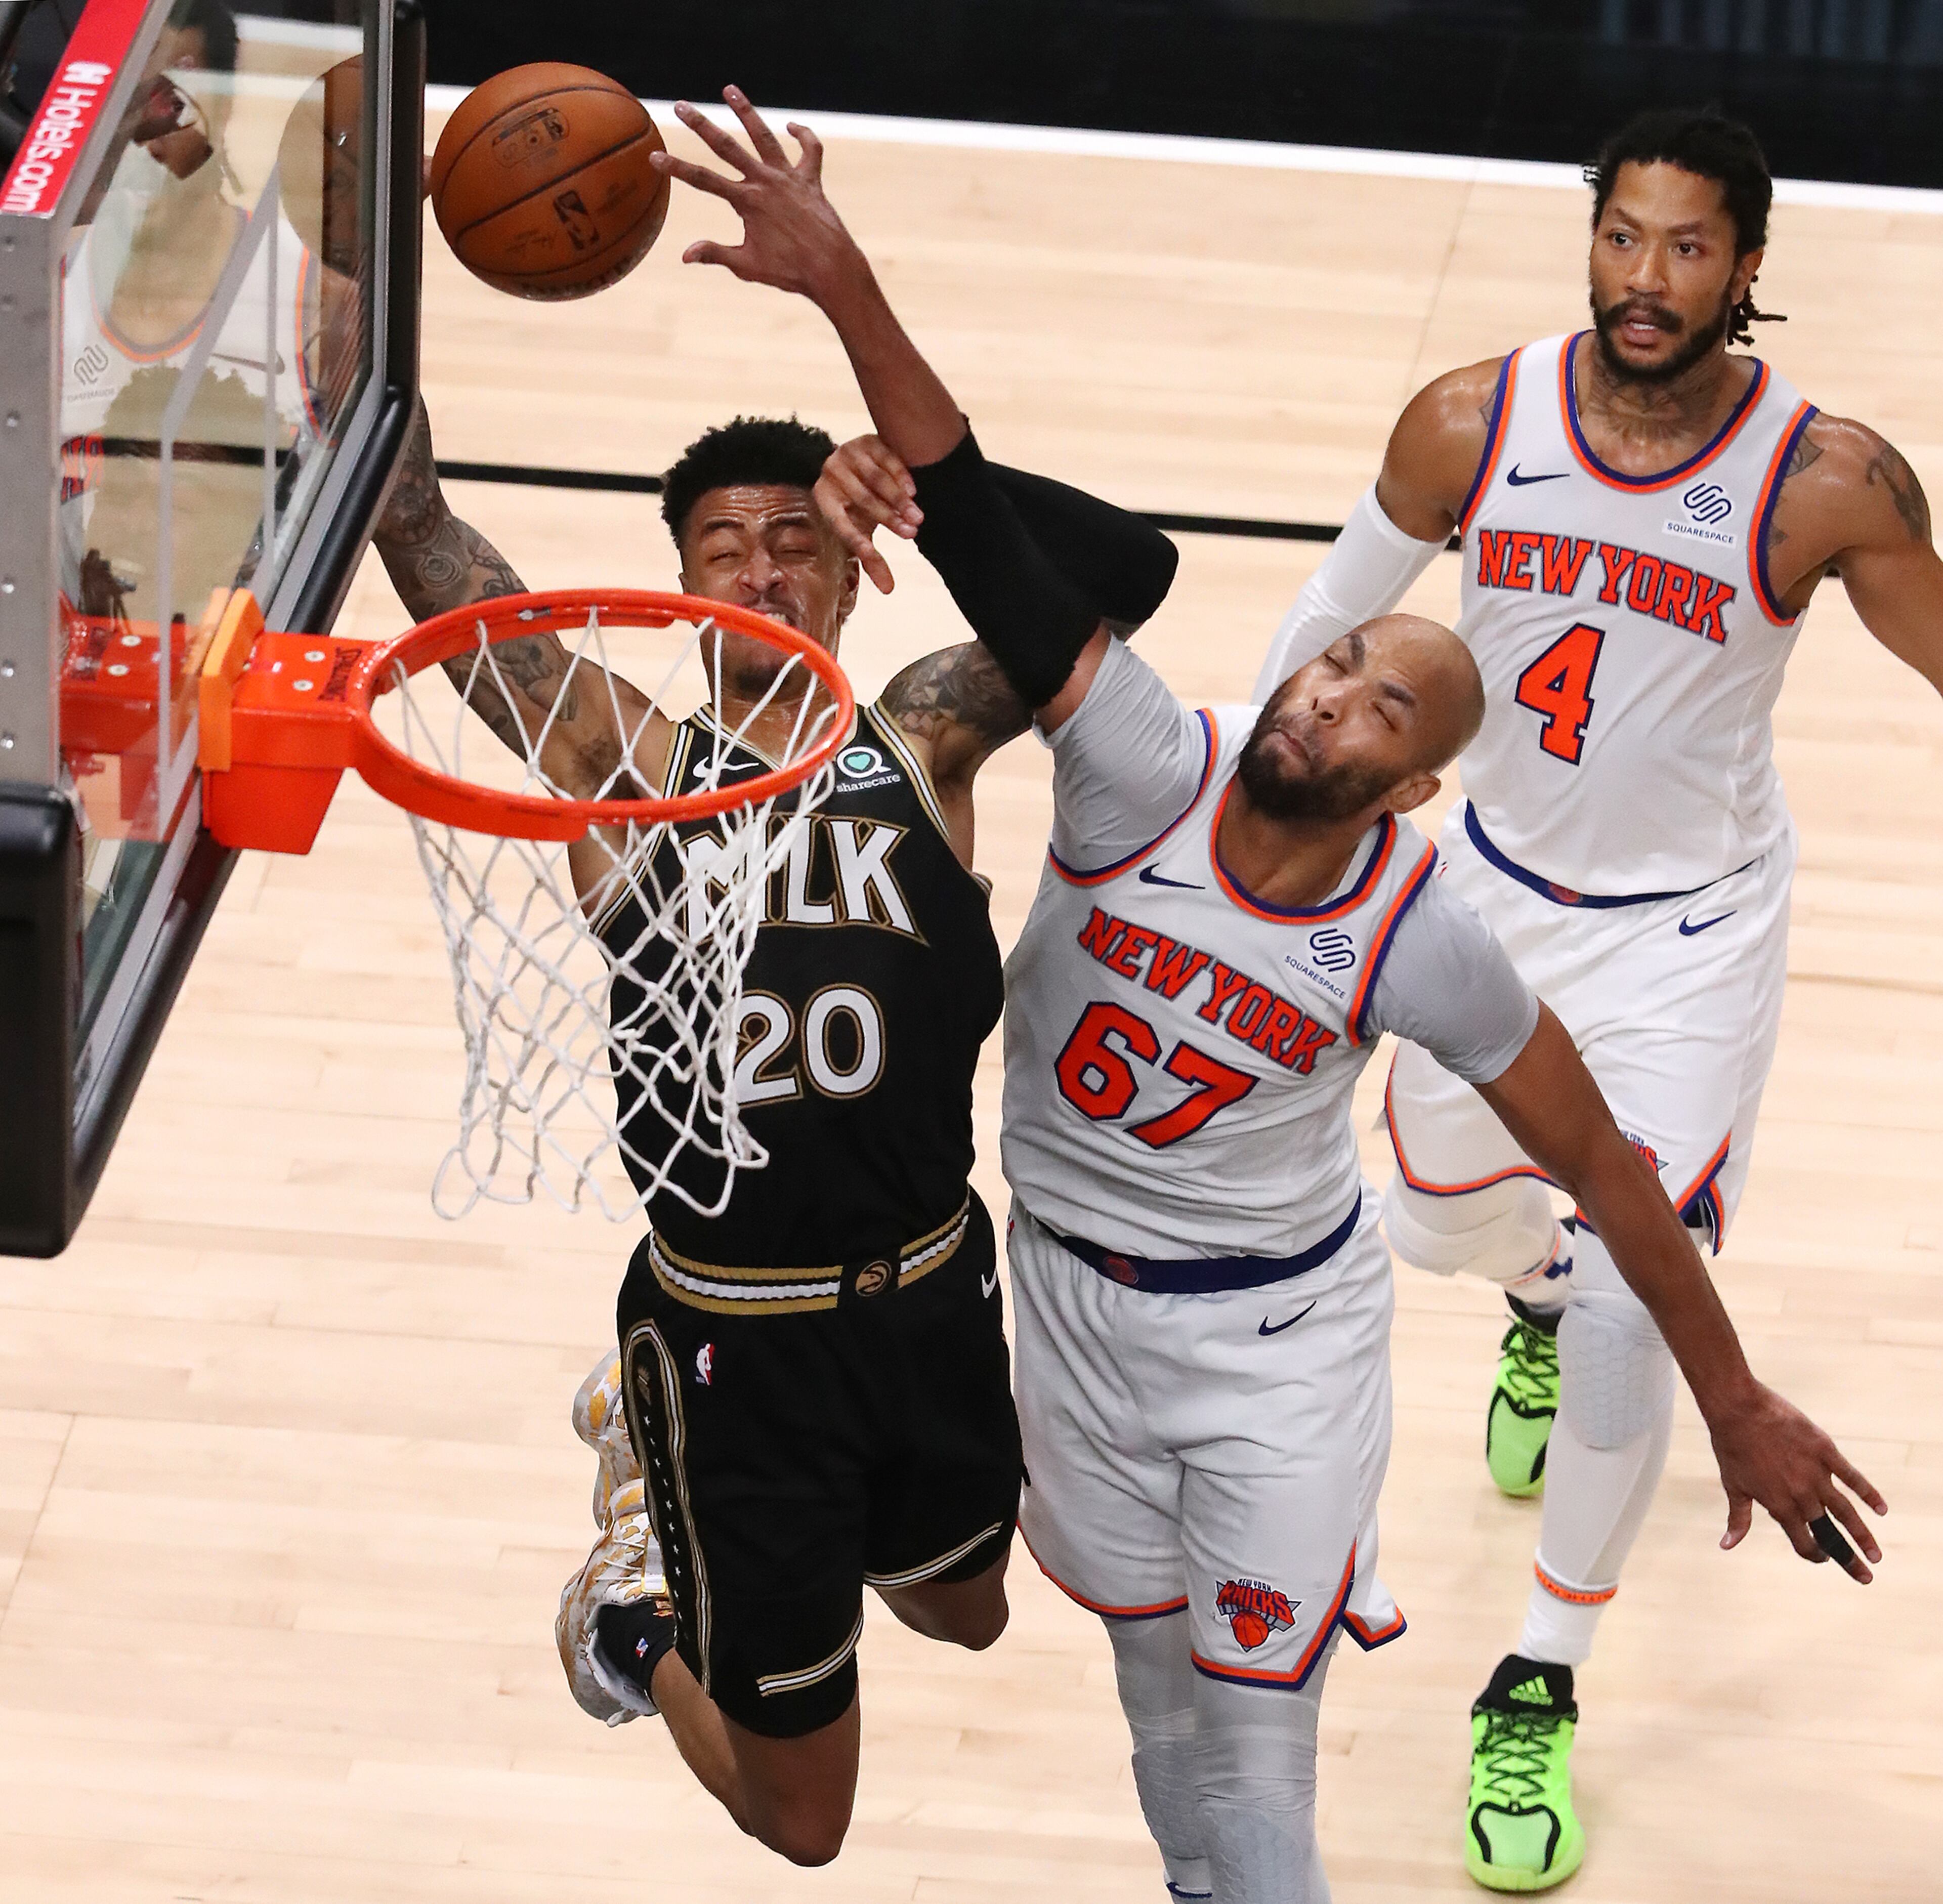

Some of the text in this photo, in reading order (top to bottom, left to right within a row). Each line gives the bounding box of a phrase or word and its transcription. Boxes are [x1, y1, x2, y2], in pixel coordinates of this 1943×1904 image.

[0, 86, 98, 212] Hotels.com
[1477, 528, 1739, 647] NEW YORK
[1667, 523, 1734, 543] SQUARESPACE
[1514, 622, 1606, 766] 4
[836, 774, 900, 792] sharecare
[682, 812, 931, 948] MLK
[1077, 905, 1340, 1076] NEW YORK
[1285, 955, 1345, 999] SQUARESPACE
[734, 982, 886, 1108] 20
[1054, 1002, 1260, 1150] 67
[1216, 1580, 1295, 1625] KNICKS
[1238, 1579, 1252, 1587] NEW
